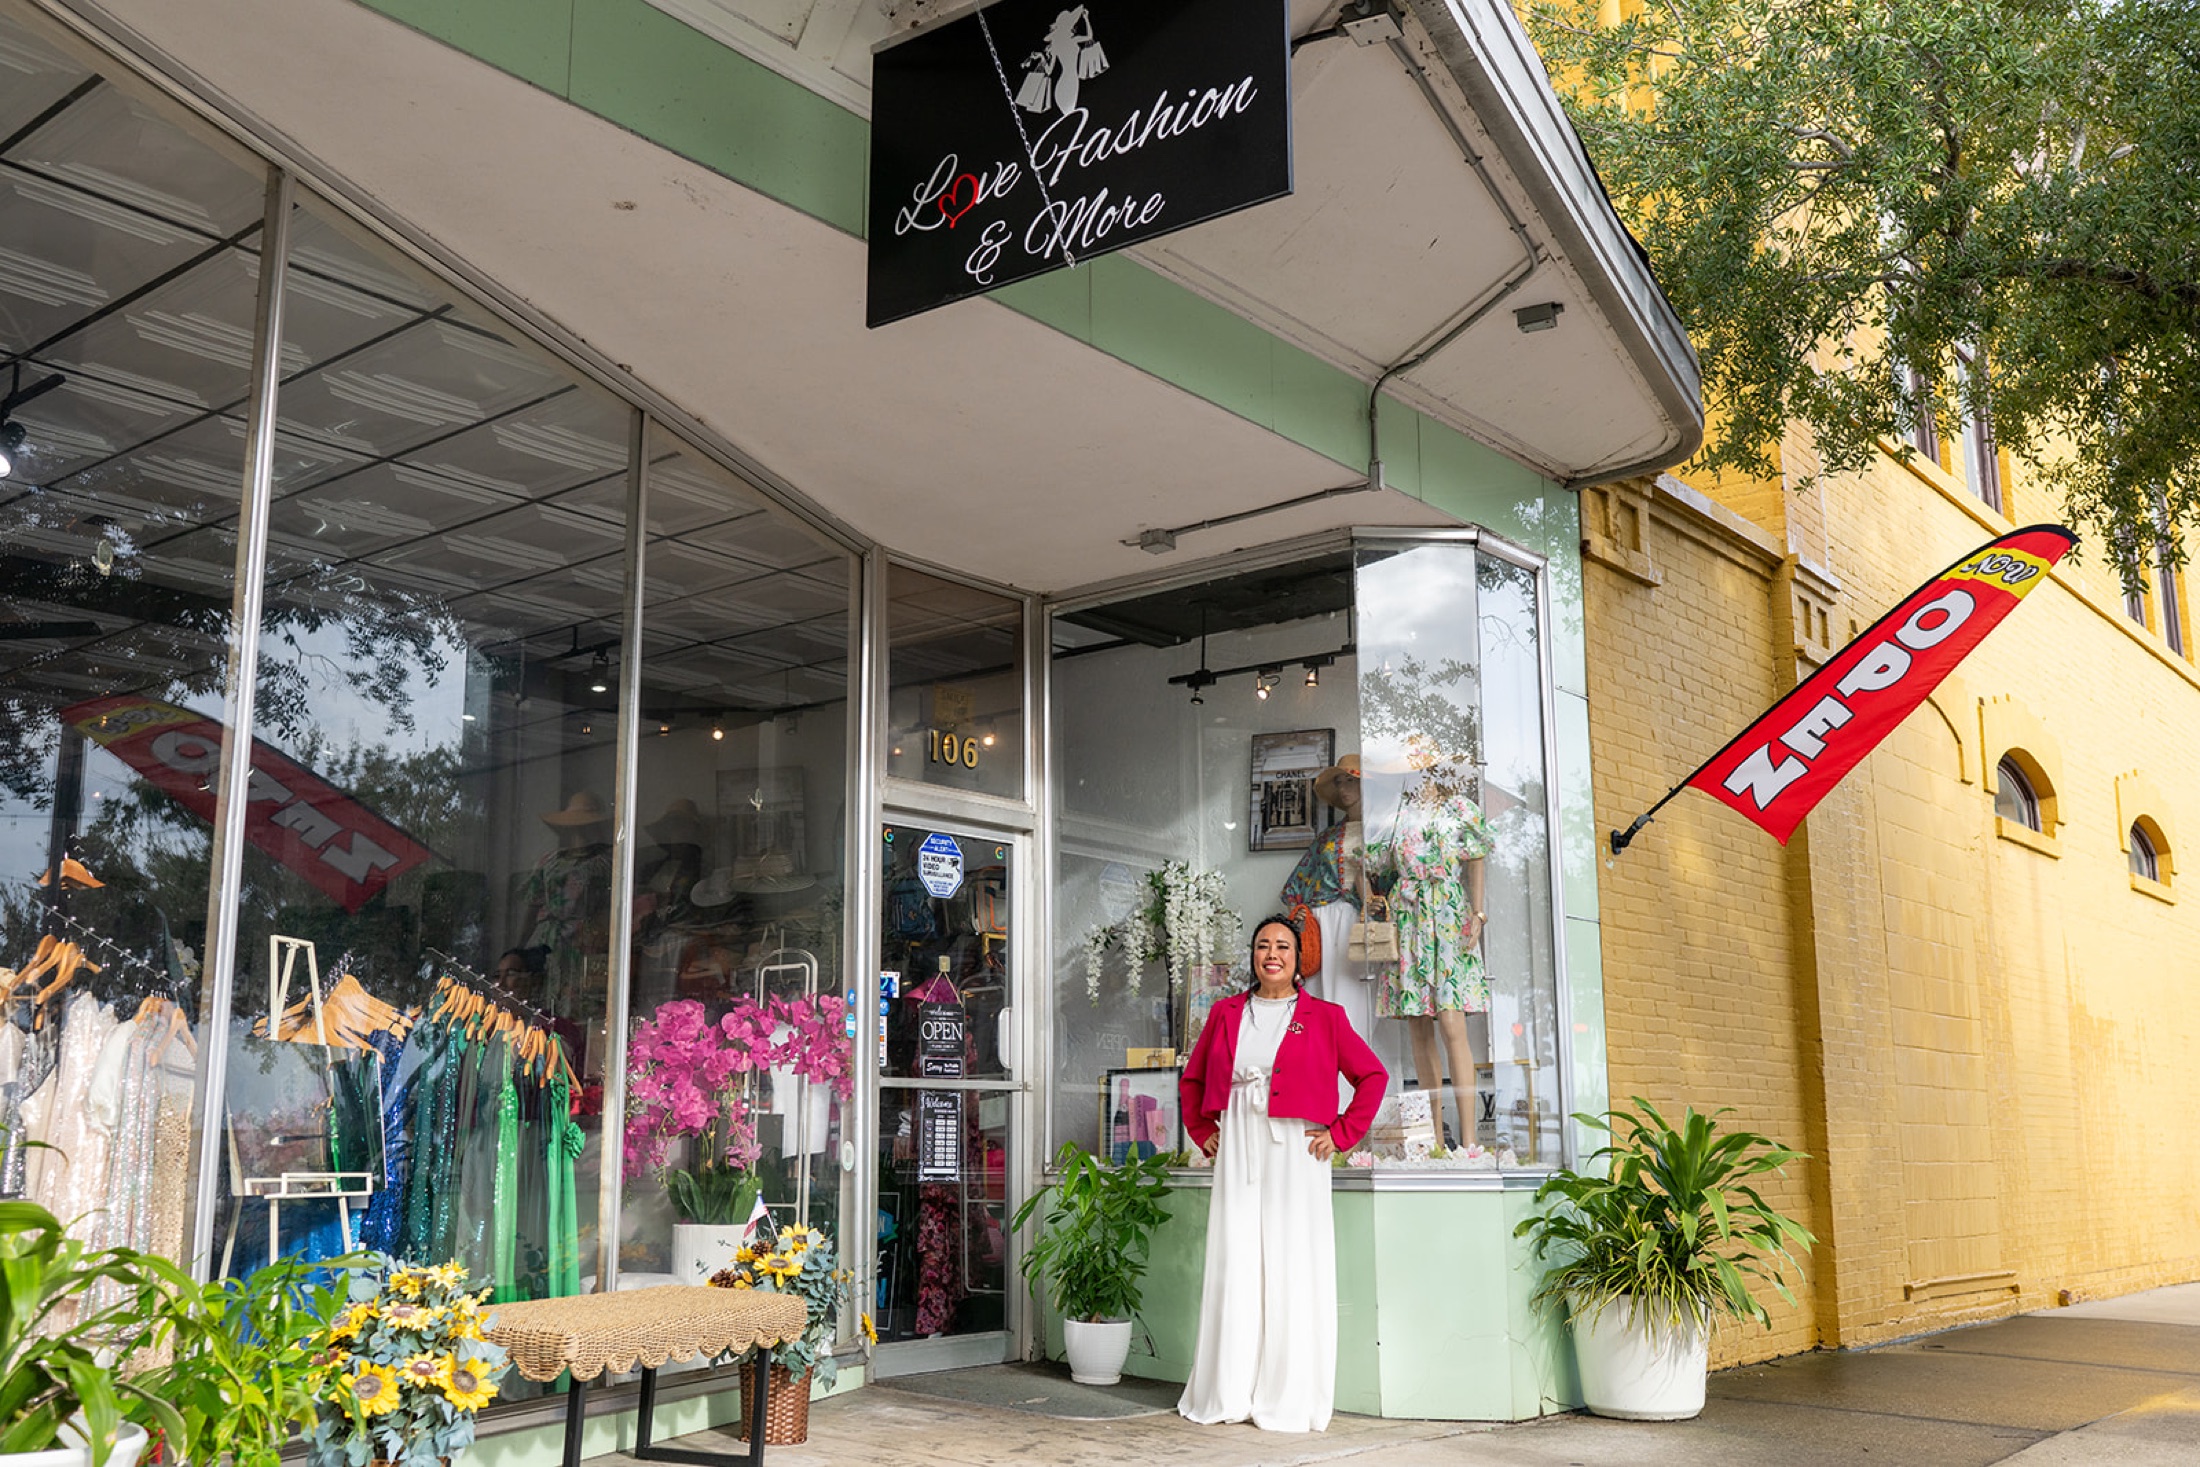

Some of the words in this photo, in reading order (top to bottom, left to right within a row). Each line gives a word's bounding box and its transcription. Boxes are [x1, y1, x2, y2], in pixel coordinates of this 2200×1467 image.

[895, 154, 1022, 236] Love
[1030, 75, 1258, 187] Fashion
[965, 220, 1012, 285] &
[1024, 187, 1166, 260] More
[1722, 588, 1976, 812] OPEN
[931, 729, 979, 770] 106
[1276, 769, 1306, 780] CHANEL
[923, 862, 940, 871] VIDEO
[931, 855, 946, 863] HOUR
[922, 1020, 964, 1042] OPEN
